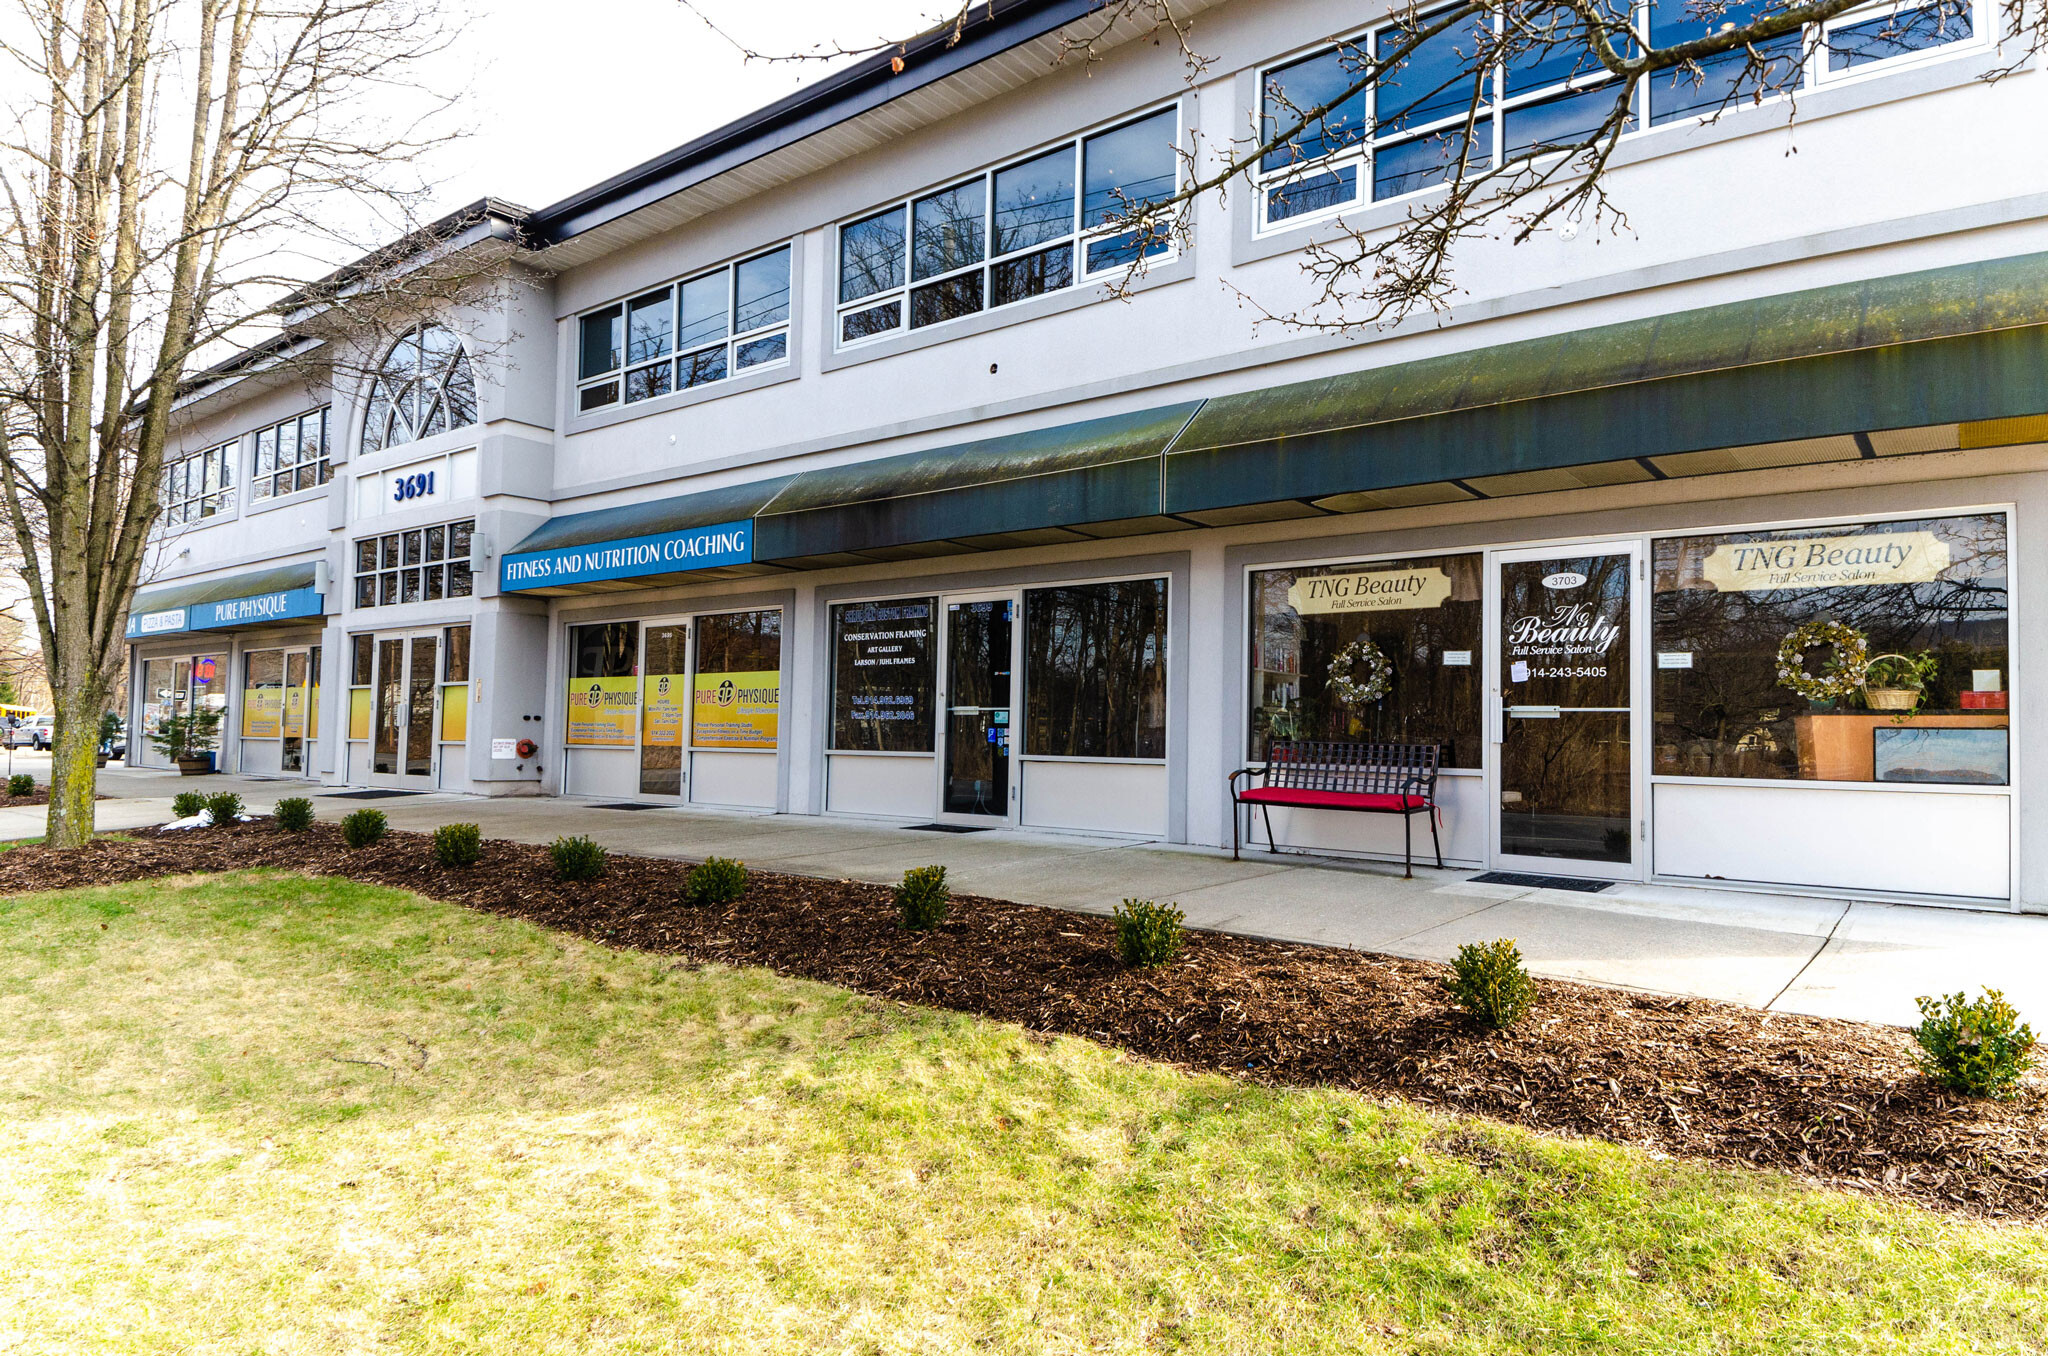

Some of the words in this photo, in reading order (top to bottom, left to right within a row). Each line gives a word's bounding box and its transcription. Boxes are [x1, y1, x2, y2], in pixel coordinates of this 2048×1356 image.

[394, 471, 434, 501] 3691
[507, 558, 551, 580] FITNESS
[553, 554, 581, 575] AND
[584, 543, 660, 570] NUTRITION
[664, 530, 745, 560] COACHING
[1734, 545, 1797, 571] TNG
[1803, 542, 1912, 569] Beauty
[1551, 576, 1577, 586] 3703
[1769, 571, 1791, 583] Full
[1792, 571, 1840, 583] Service
[1841, 569, 1876, 581] Salon
[1308, 577, 1350, 599] TNG
[1354, 575, 1427, 597] Beauty
[215, 603, 238, 622] PURE
[239, 594, 287, 619] PHYSIQUE
[970, 602, 993, 613] 3699
[1330, 600, 1346, 609] Full
[1346, 598, 1376, 608] Service
[1377, 597, 1402, 607] Salon
[902, 604, 928, 618] FRAMING
[143, 616, 158, 629] PIZZA
[165, 613, 182, 626] PASTA
[844, 631, 895, 641] CONSERVATION
[895, 629, 927, 639] FRAMING
[1508, 615, 1620, 653] Beauty
[1512, 646, 1529, 656] Full
[1529, 645, 1563, 655] Service
[1564, 645, 1592, 655] Salon
[570, 692, 587, 706] PURE
[604, 691, 637, 706] PHYSIQUE
[695, 689, 717, 704] PURE
[737, 688, 779, 704] PHYSIQUE
